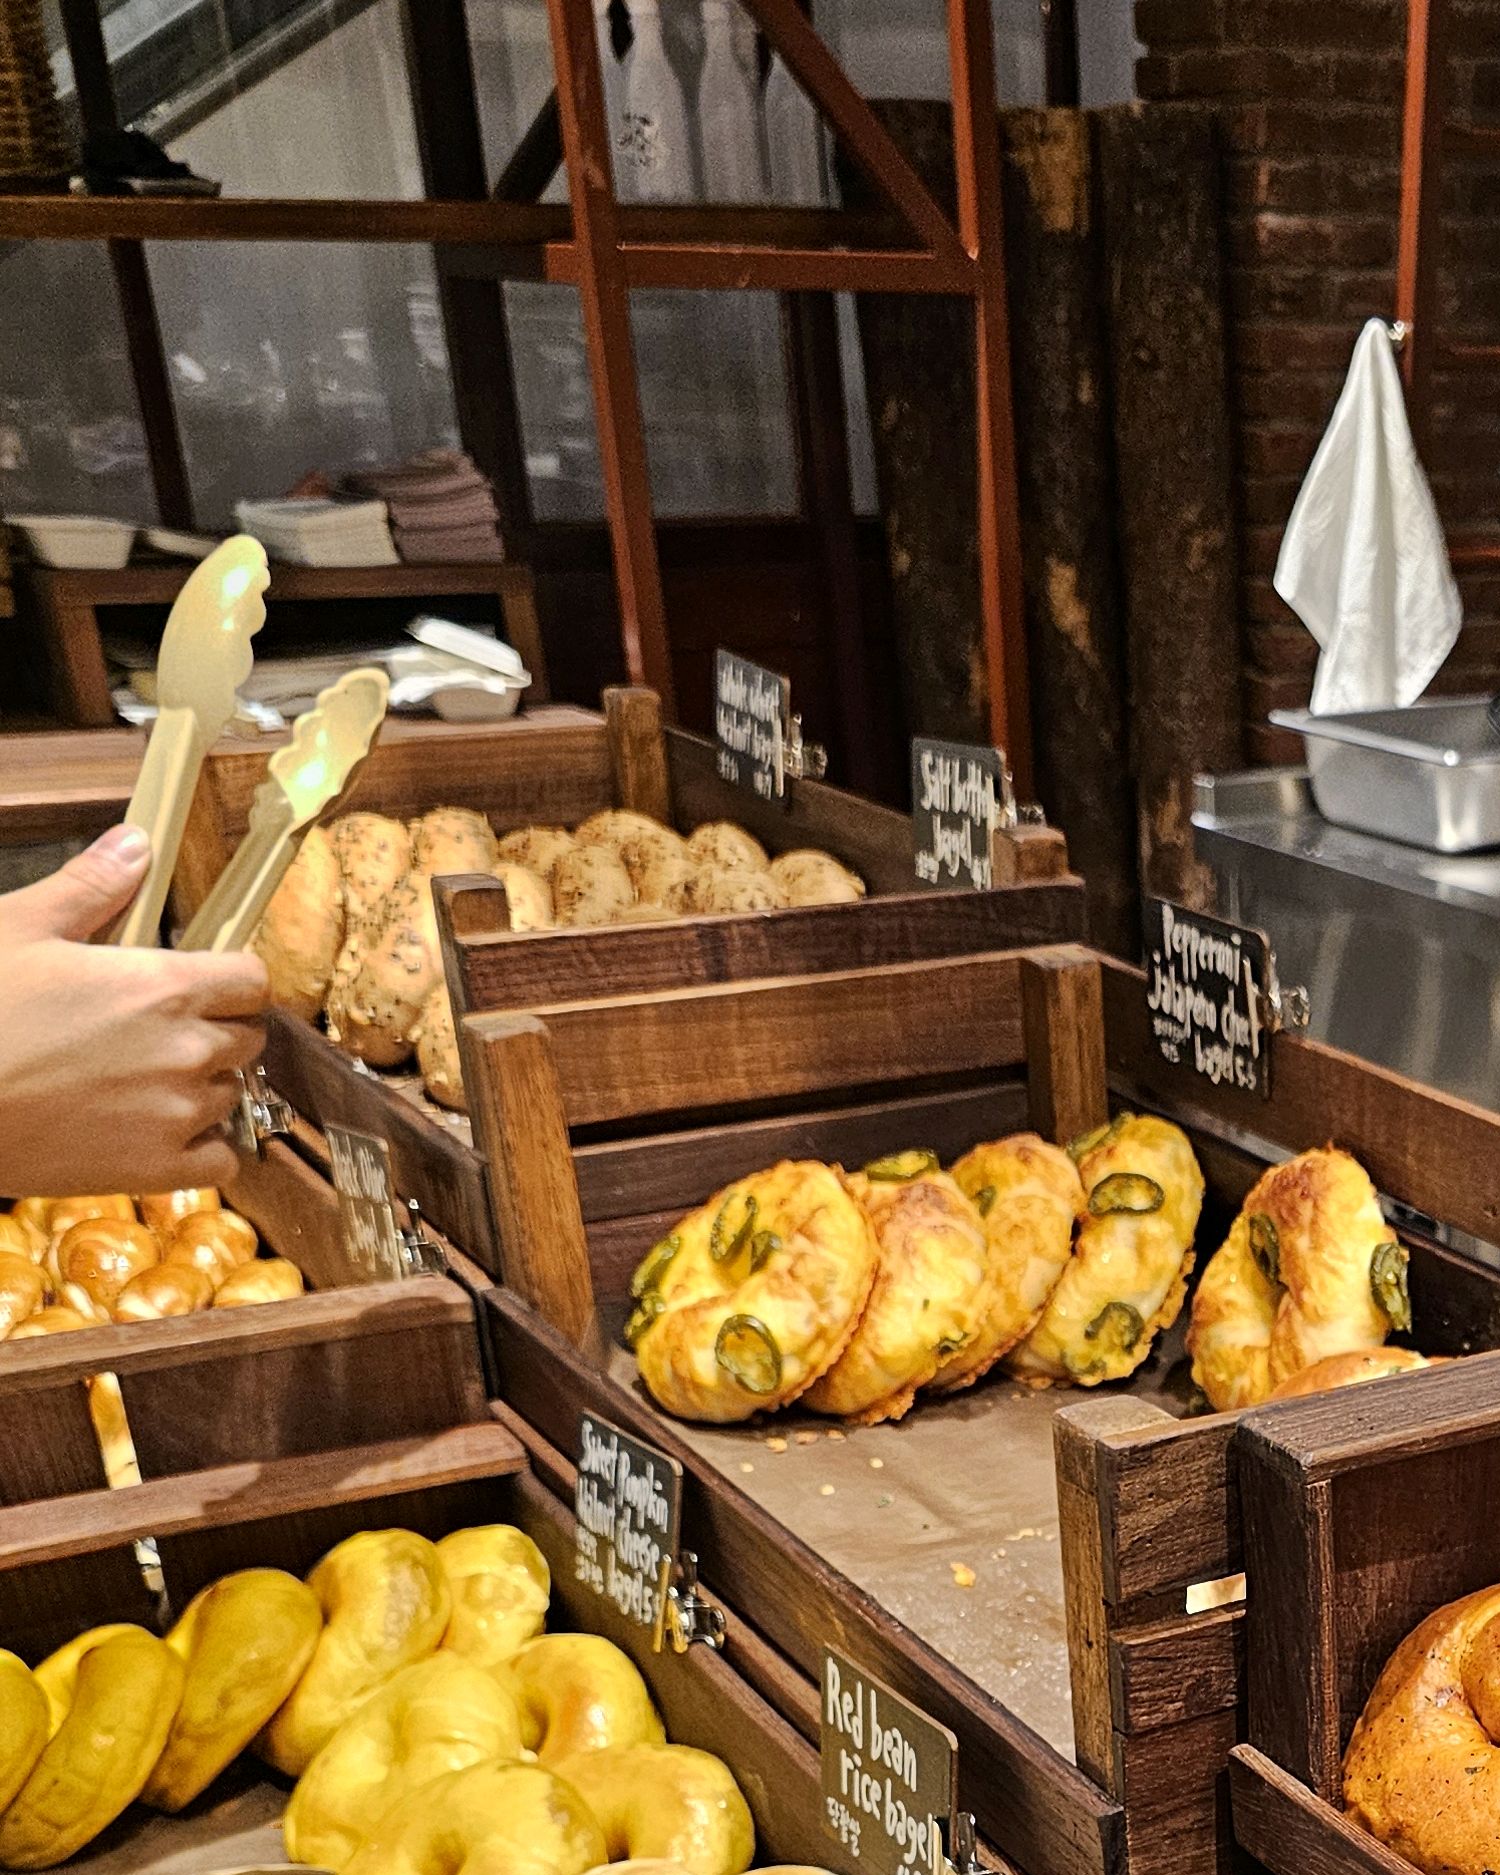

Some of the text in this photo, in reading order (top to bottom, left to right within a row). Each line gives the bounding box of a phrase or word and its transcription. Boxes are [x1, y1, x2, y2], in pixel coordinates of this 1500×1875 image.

[1162, 903, 1242, 986] Pepperoni
[1194, 1031, 1235, 1085] bagel
[826, 1657, 918, 1793] Red bean
[840, 1748, 934, 1870] rice bagel
